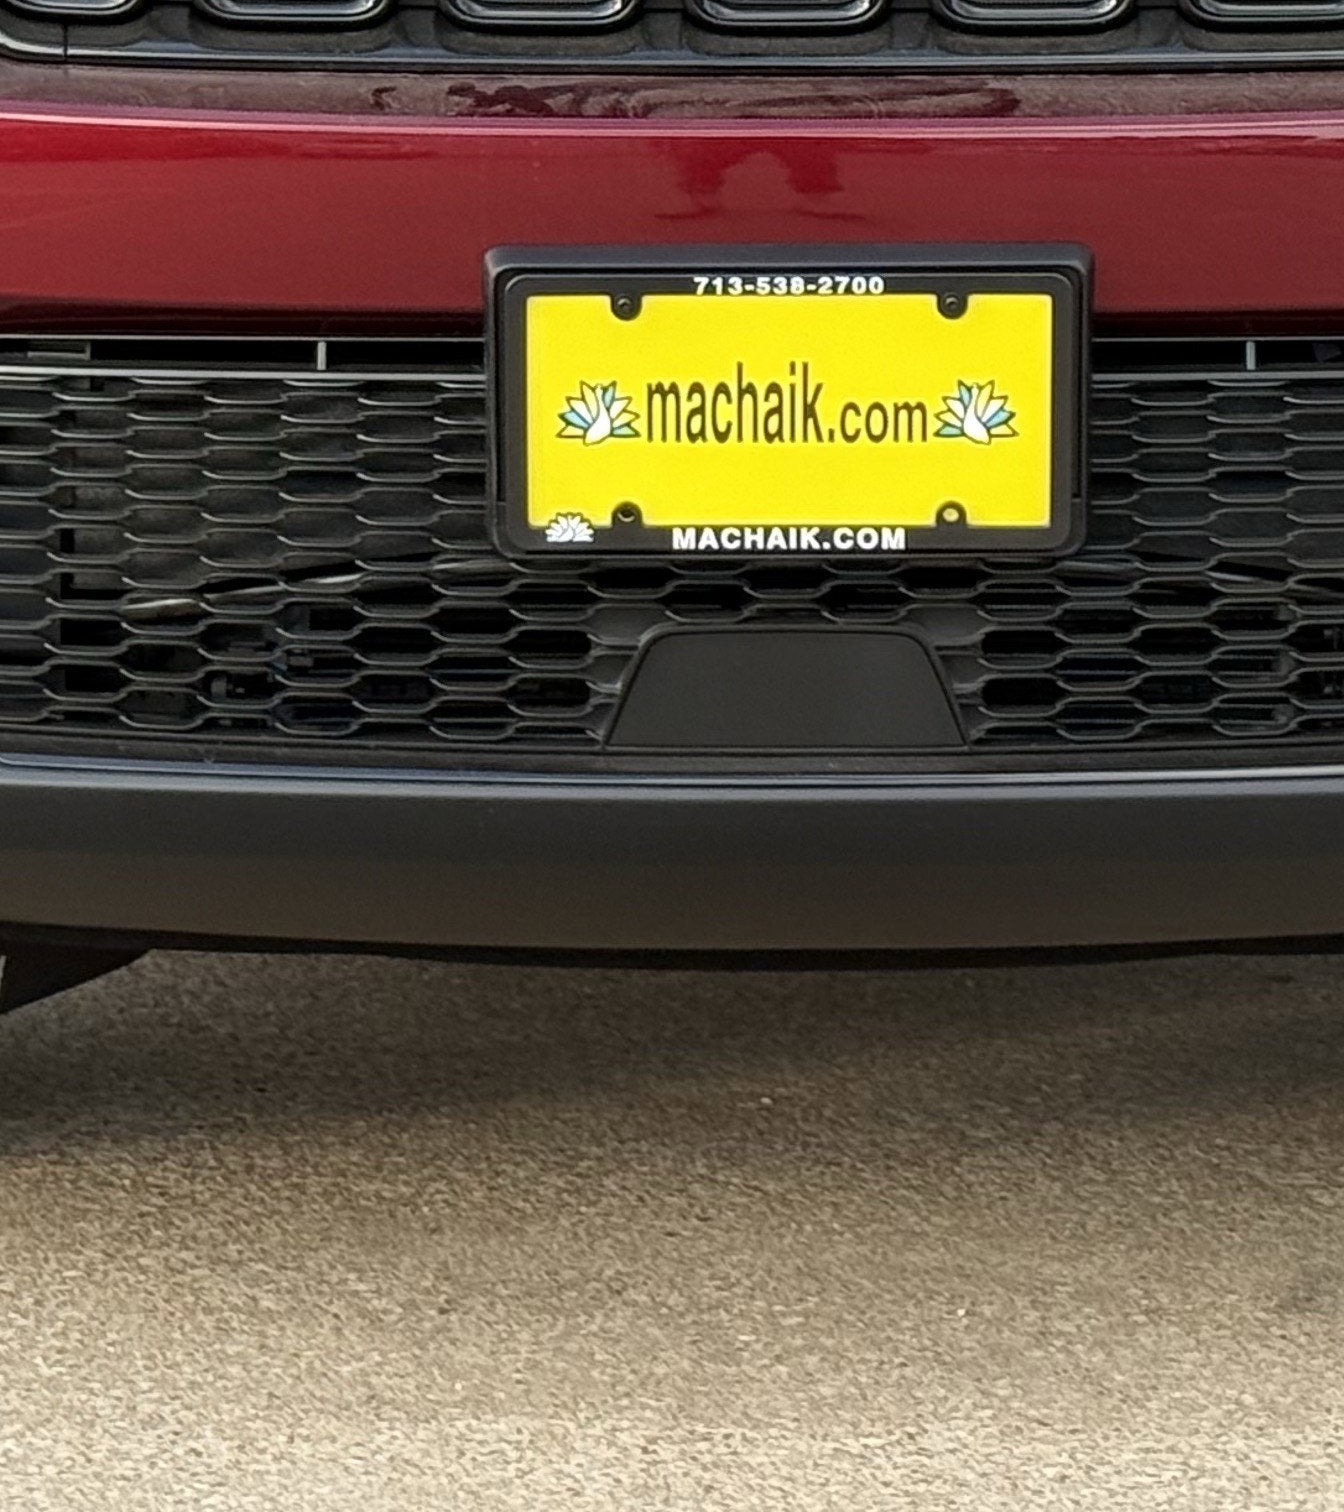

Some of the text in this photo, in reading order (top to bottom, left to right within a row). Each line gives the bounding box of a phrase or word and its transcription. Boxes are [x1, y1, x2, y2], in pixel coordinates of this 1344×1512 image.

[693, 277, 884, 295] 713-538-2700
[646, 361, 928, 444] machaik.com
[672, 527, 905, 550] MACHAIK.COM
